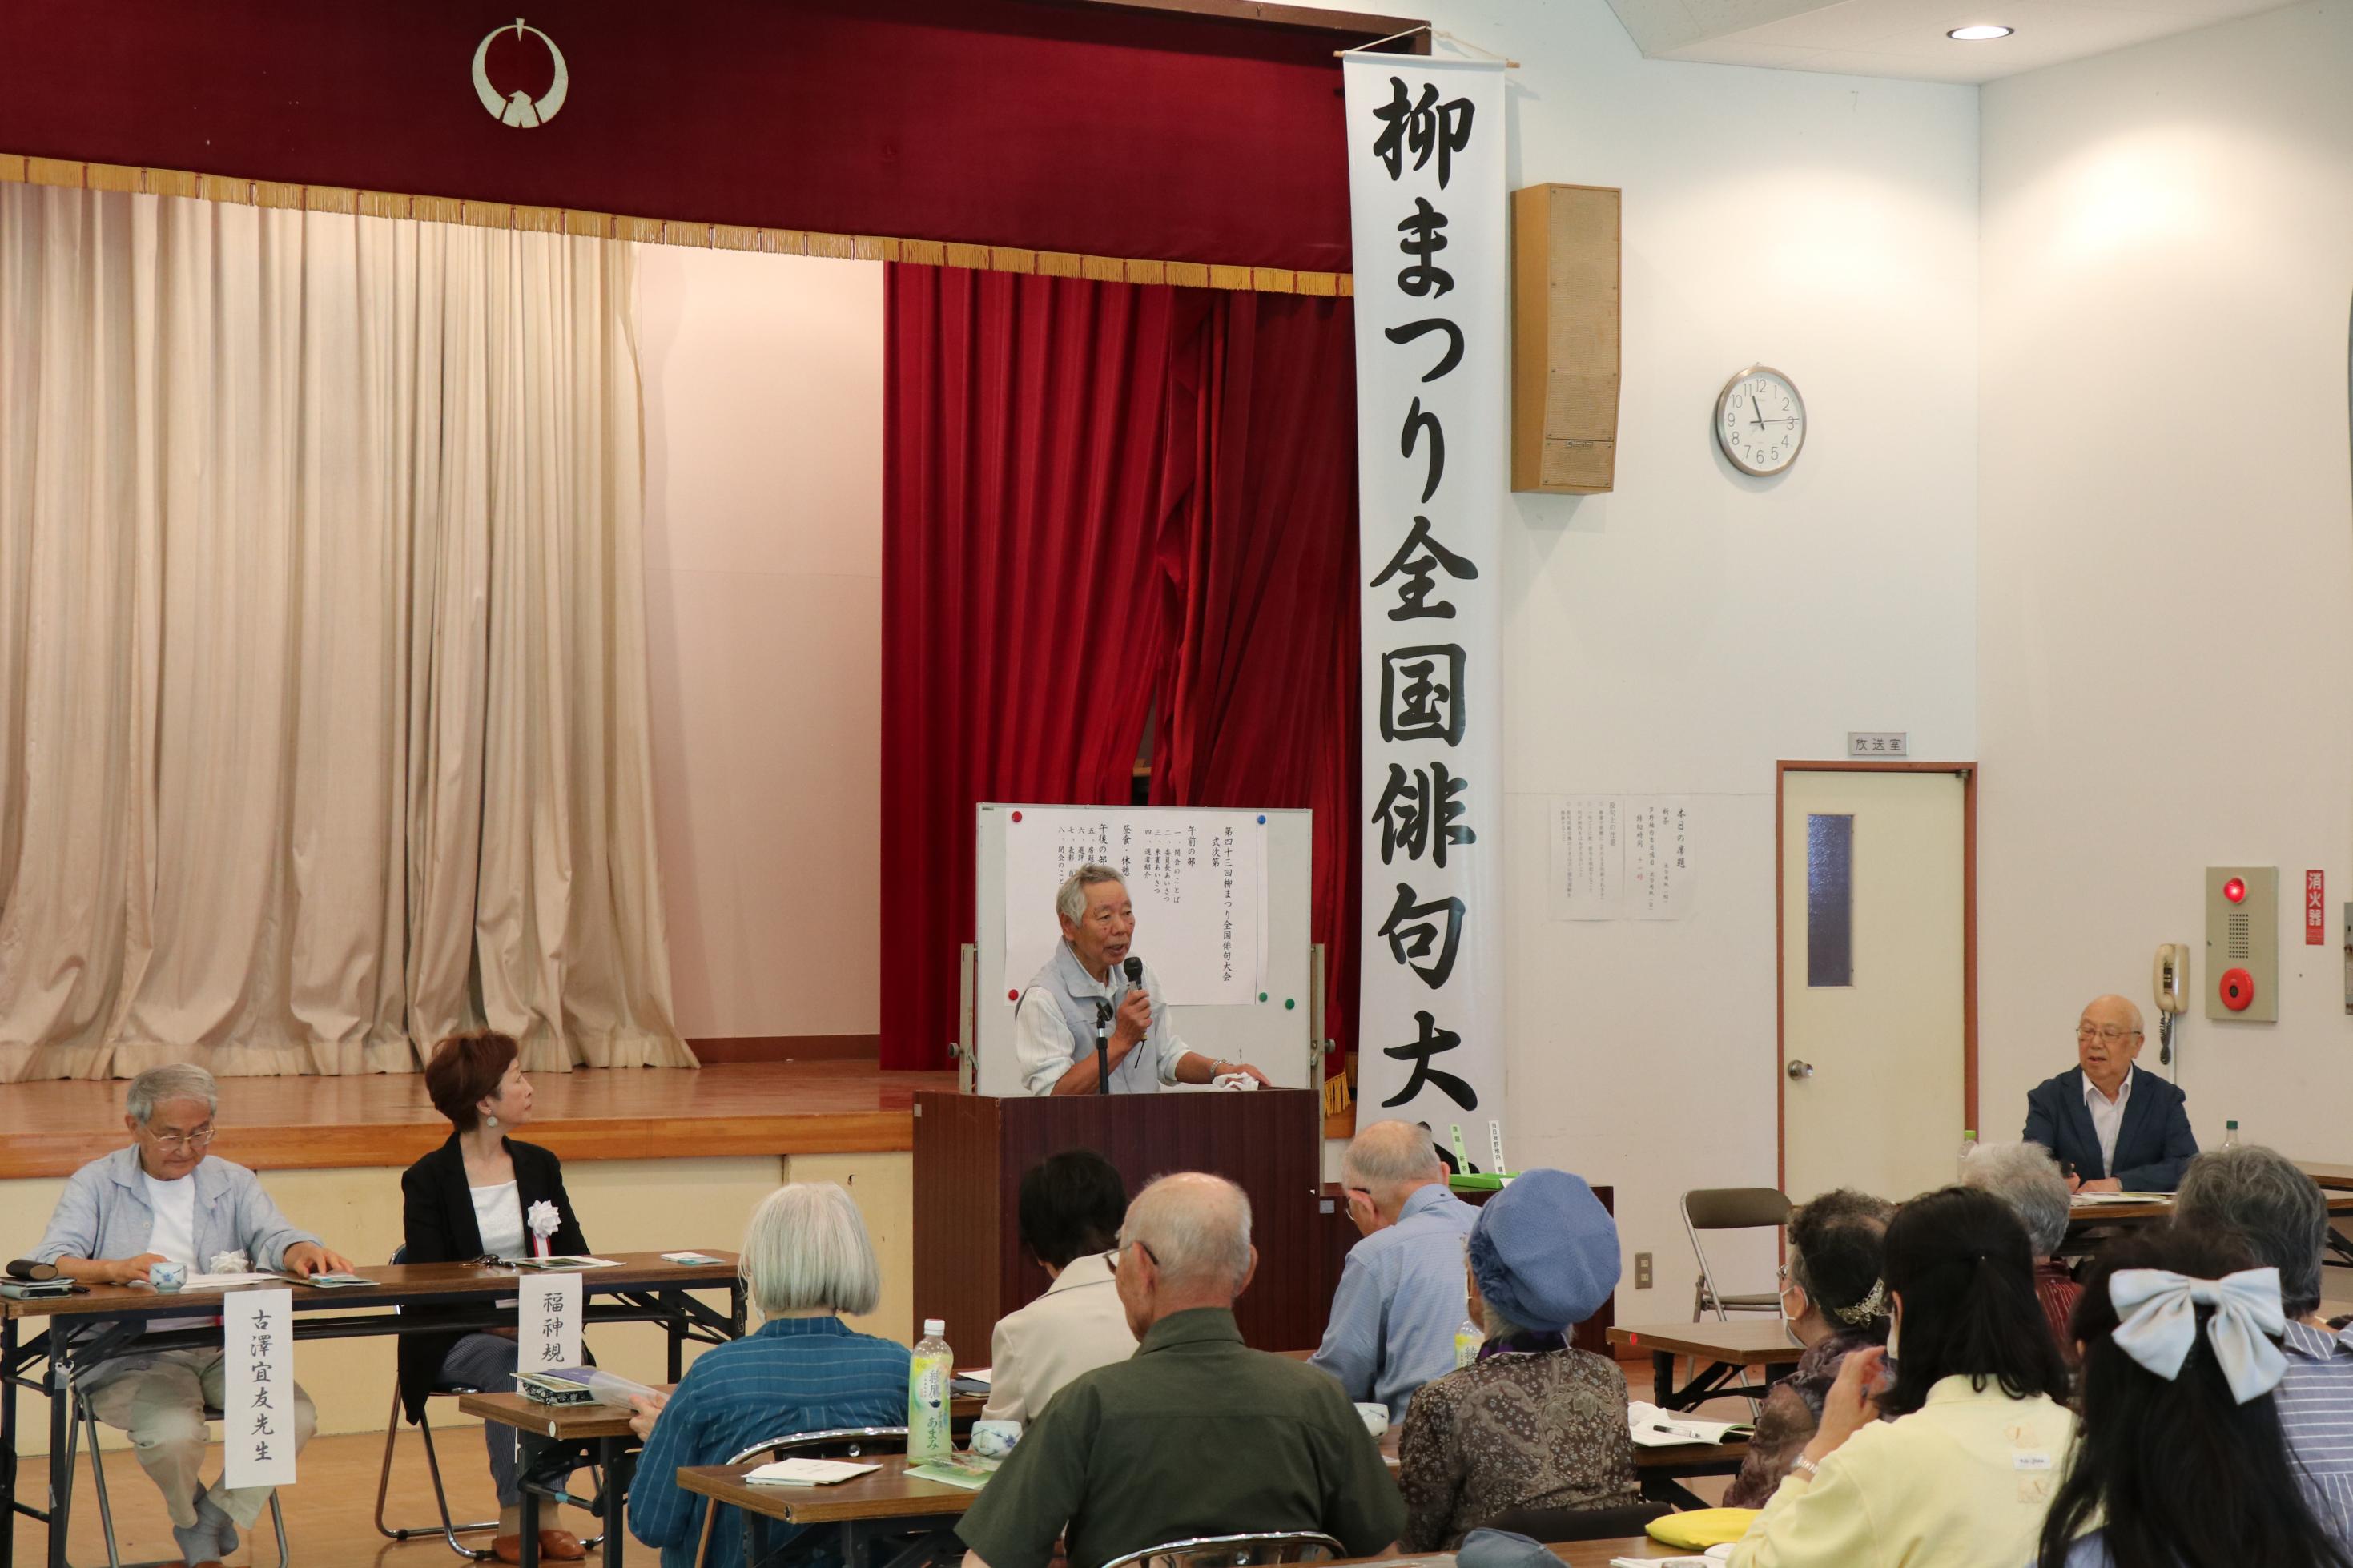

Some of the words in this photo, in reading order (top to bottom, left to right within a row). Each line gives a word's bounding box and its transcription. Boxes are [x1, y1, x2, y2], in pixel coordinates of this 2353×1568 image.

[1744, 384, 1752, 397] 11
[1756, 379, 1767, 393] 12
[1732, 394, 1743, 408] 10
[1782, 397, 1790, 411] 2
[1728, 412, 1736, 427] 9
[1787, 416, 1795, 430] 3
[1732, 431, 1740, 445] 8
[1781, 435, 1789, 448] 4
[1744, 445, 1752, 459] 7
[1756, 450, 1764, 464] 6
[1771, 447, 1779, 460] 5
[1855, 737, 1902, 751] 放送室
[1098, 823, 1108, 865] 午後の部
[1187, 826, 1197, 866] 午前の部
[1211, 837, 1221, 868] 式次第
[1222, 826, 1233, 983] 第四十三回柳まつり全国俳句大会
[2307, 872, 2323, 927] 消火器
[541, 1292, 565, 1370] 福神規
[251, 1309, 275, 1461] 古澤宜友先生
[927, 1417, 939, 1451] あまみ
